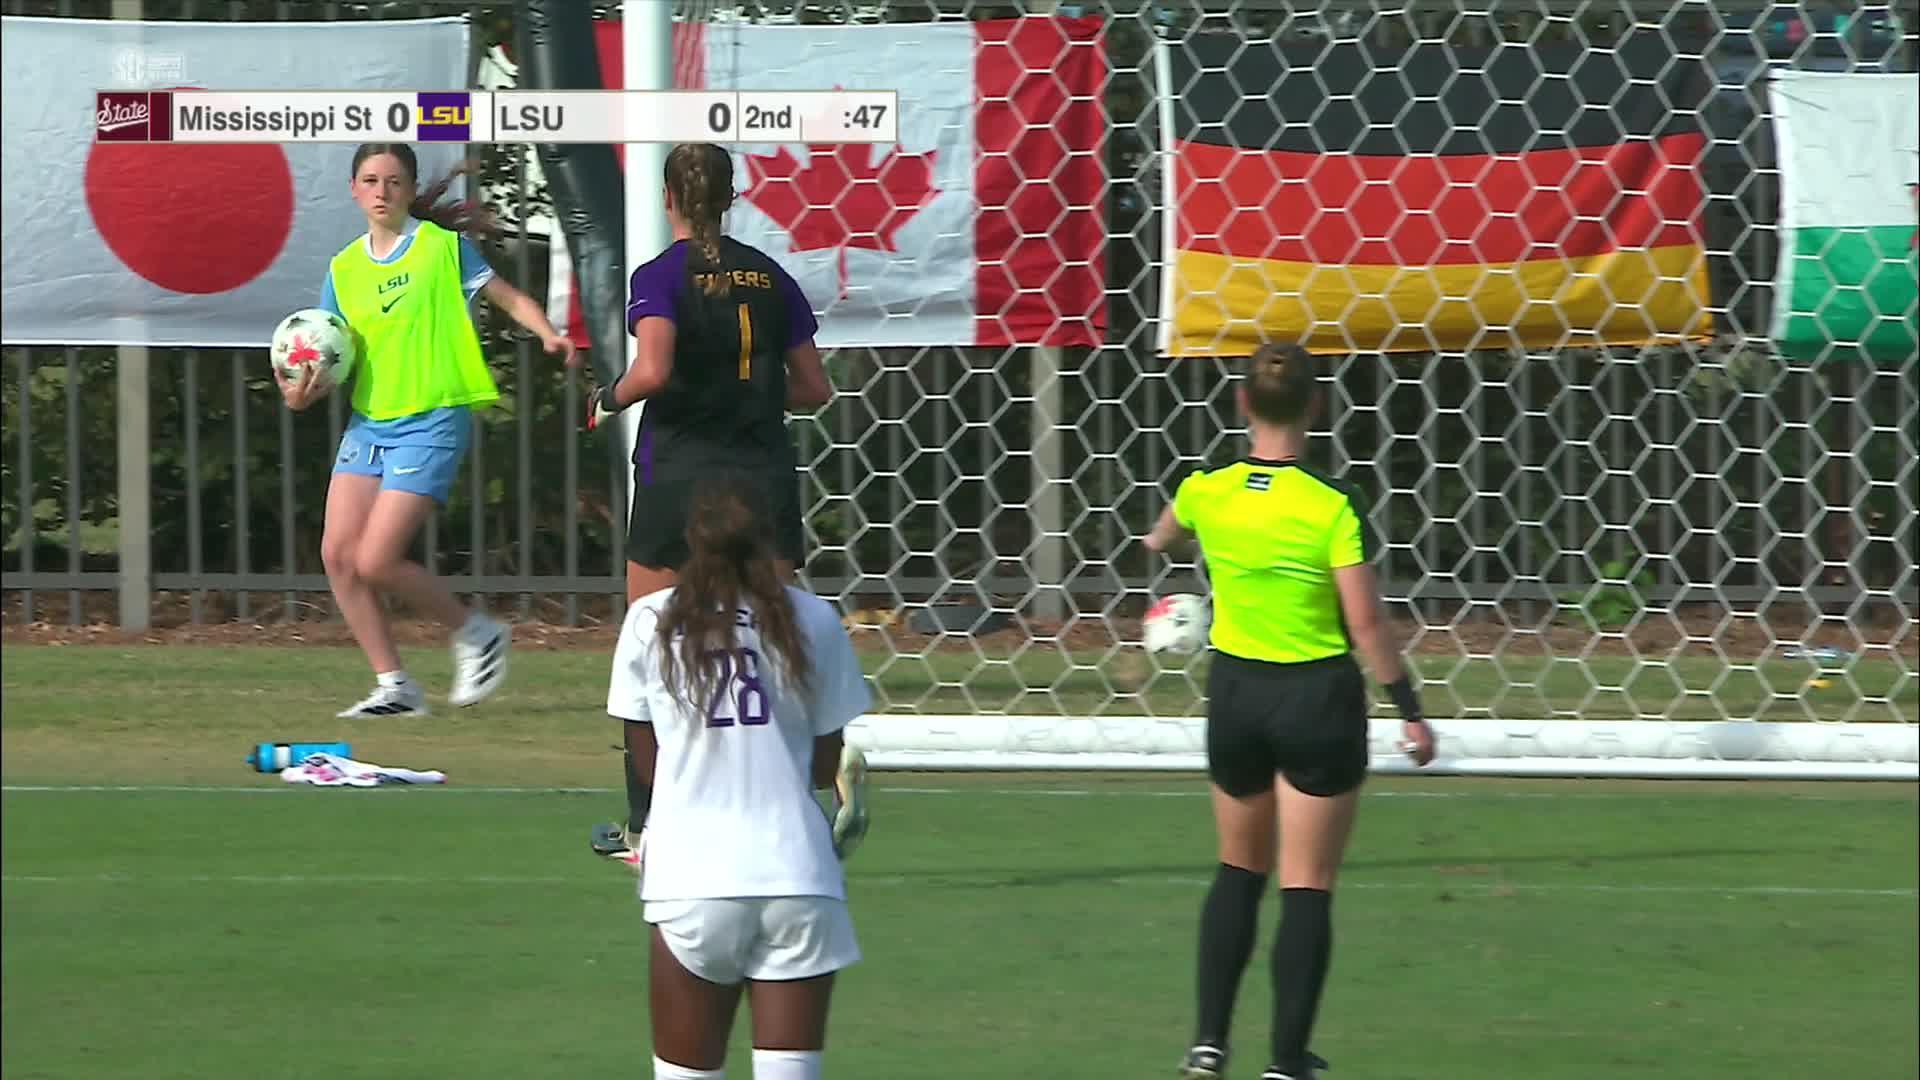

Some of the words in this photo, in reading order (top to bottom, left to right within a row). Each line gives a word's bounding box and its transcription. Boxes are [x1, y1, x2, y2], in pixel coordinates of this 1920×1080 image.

[378, 272, 409, 294] LSU
[694, 270, 771, 290] TIERS
[737, 302, 752, 380] 1
[705, 647, 770, 728] 28
